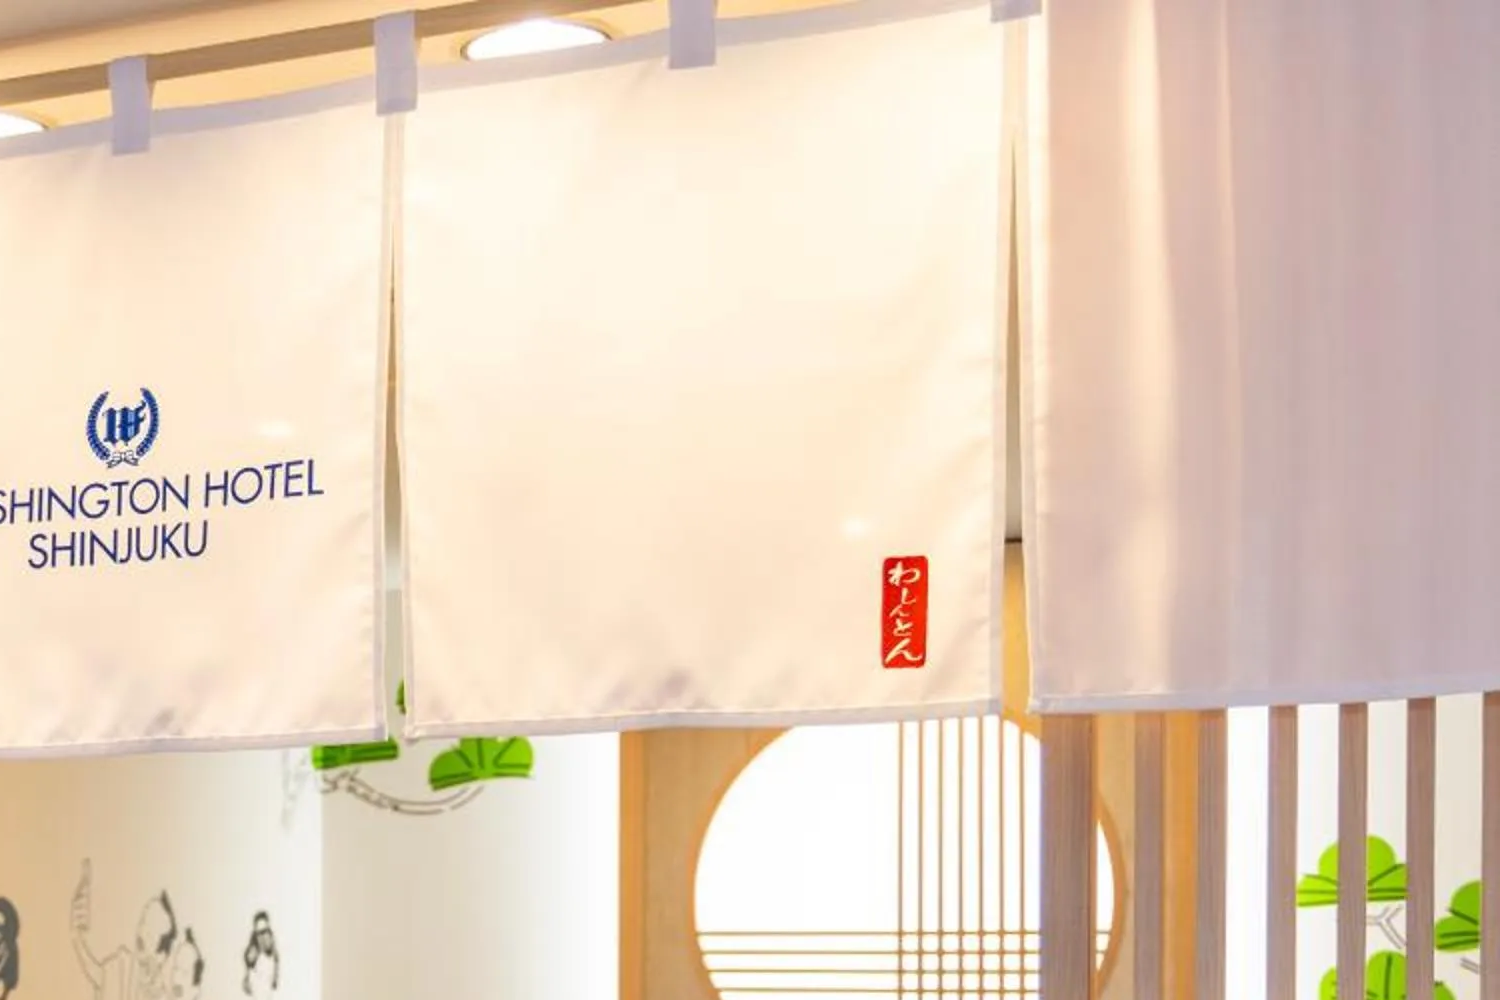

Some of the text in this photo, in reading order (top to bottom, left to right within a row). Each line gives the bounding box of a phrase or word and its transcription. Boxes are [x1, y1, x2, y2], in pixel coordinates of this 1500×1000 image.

[204, 458, 325, 508] HOTEL
[28, 520, 208, 569] SHINJUKU
[884, 560, 923, 664] わしんとん
